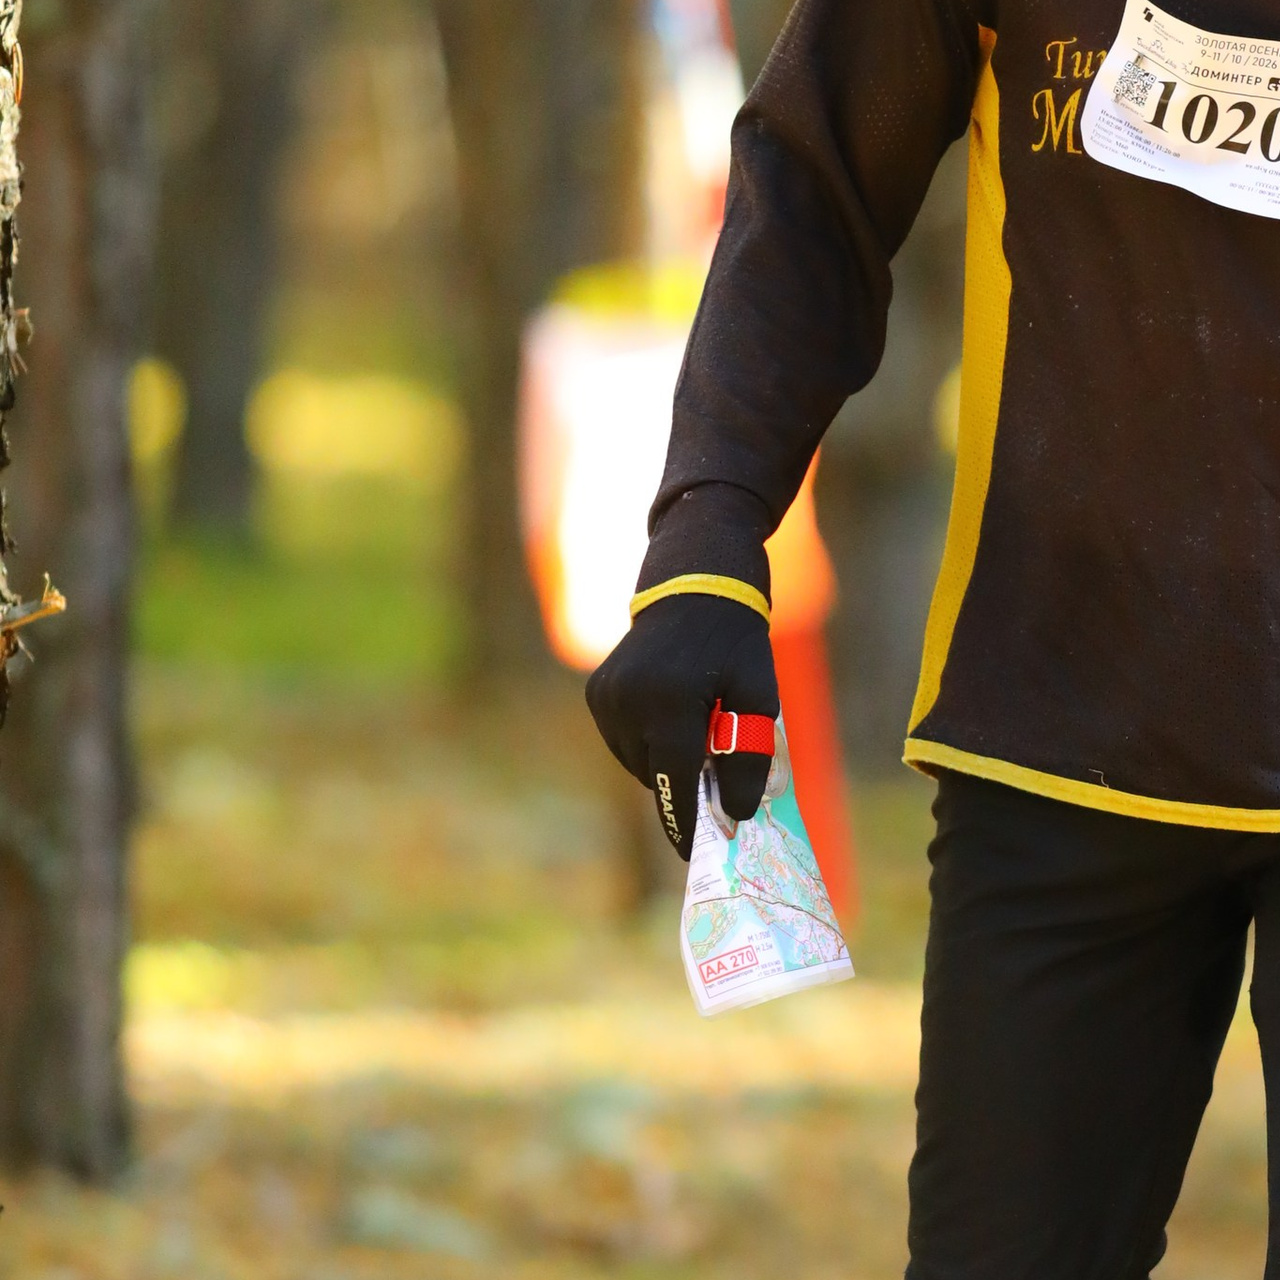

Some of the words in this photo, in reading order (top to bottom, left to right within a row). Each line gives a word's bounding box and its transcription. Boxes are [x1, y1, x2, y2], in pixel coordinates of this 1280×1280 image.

[1194, 34, 1247, 52] ЗОЛОТАЯ
[1232, 54, 1243, 64] 10
[1253, 58, 1278, 70] 2026
[1190, 66, 1262, 87] ДОМИНТЕР
[656, 772, 679, 835] CRAFT
[730, 950, 754, 968] 270
